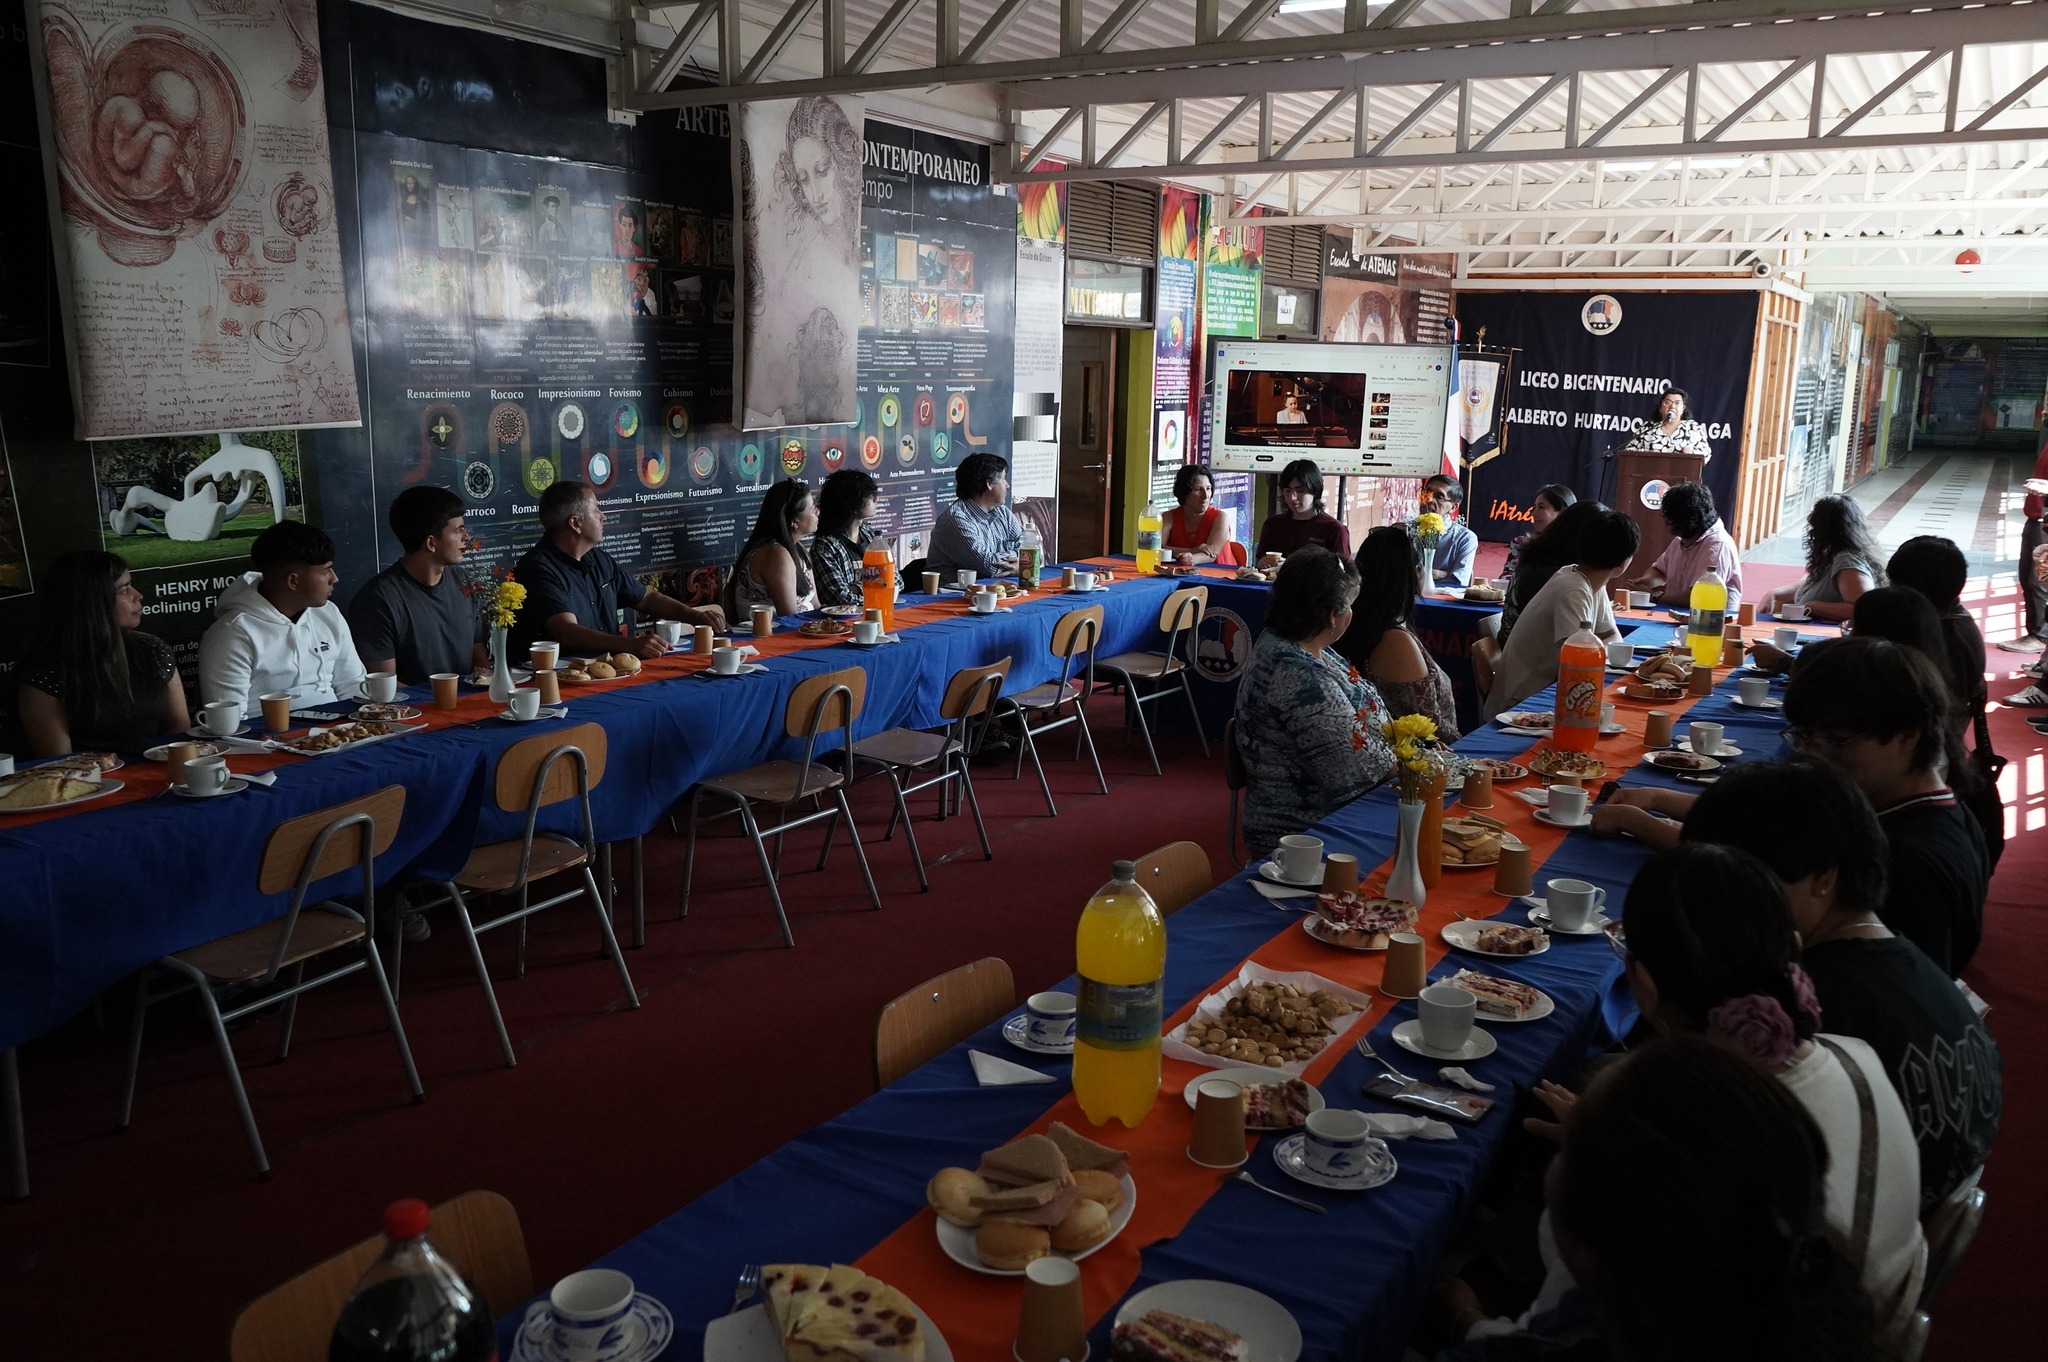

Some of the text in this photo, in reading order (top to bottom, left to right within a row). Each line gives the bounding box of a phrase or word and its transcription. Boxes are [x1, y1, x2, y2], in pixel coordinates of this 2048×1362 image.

[676, 105, 730, 138] ARTE
[390, 158, 415, 168] Leonardo
[862, 139, 981, 186] ONTEMPORANEO
[1368, 256, 1397, 277] ATENAS
[1520, 370, 1673, 395] LICEO BICENTENARIO
[406, 388, 471, 400] Renacimiento
[490, 388, 524, 400] Rococo
[538, 388, 601, 401] Impresionismo
[609, 388, 642, 398] Fovismo
[663, 388, 693, 399] Cubismo
[1506, 408, 1568, 428] ALBERTO
[1574, 412, 1644, 434] HURTADO
[635, 490, 684, 504] Expresionismo
[688, 486, 723, 498] Futurismo
[464, 507, 496, 517] arroco
[155, 576, 236, 597] HENRY MO
[142, 596, 217, 615] eclining Fi
